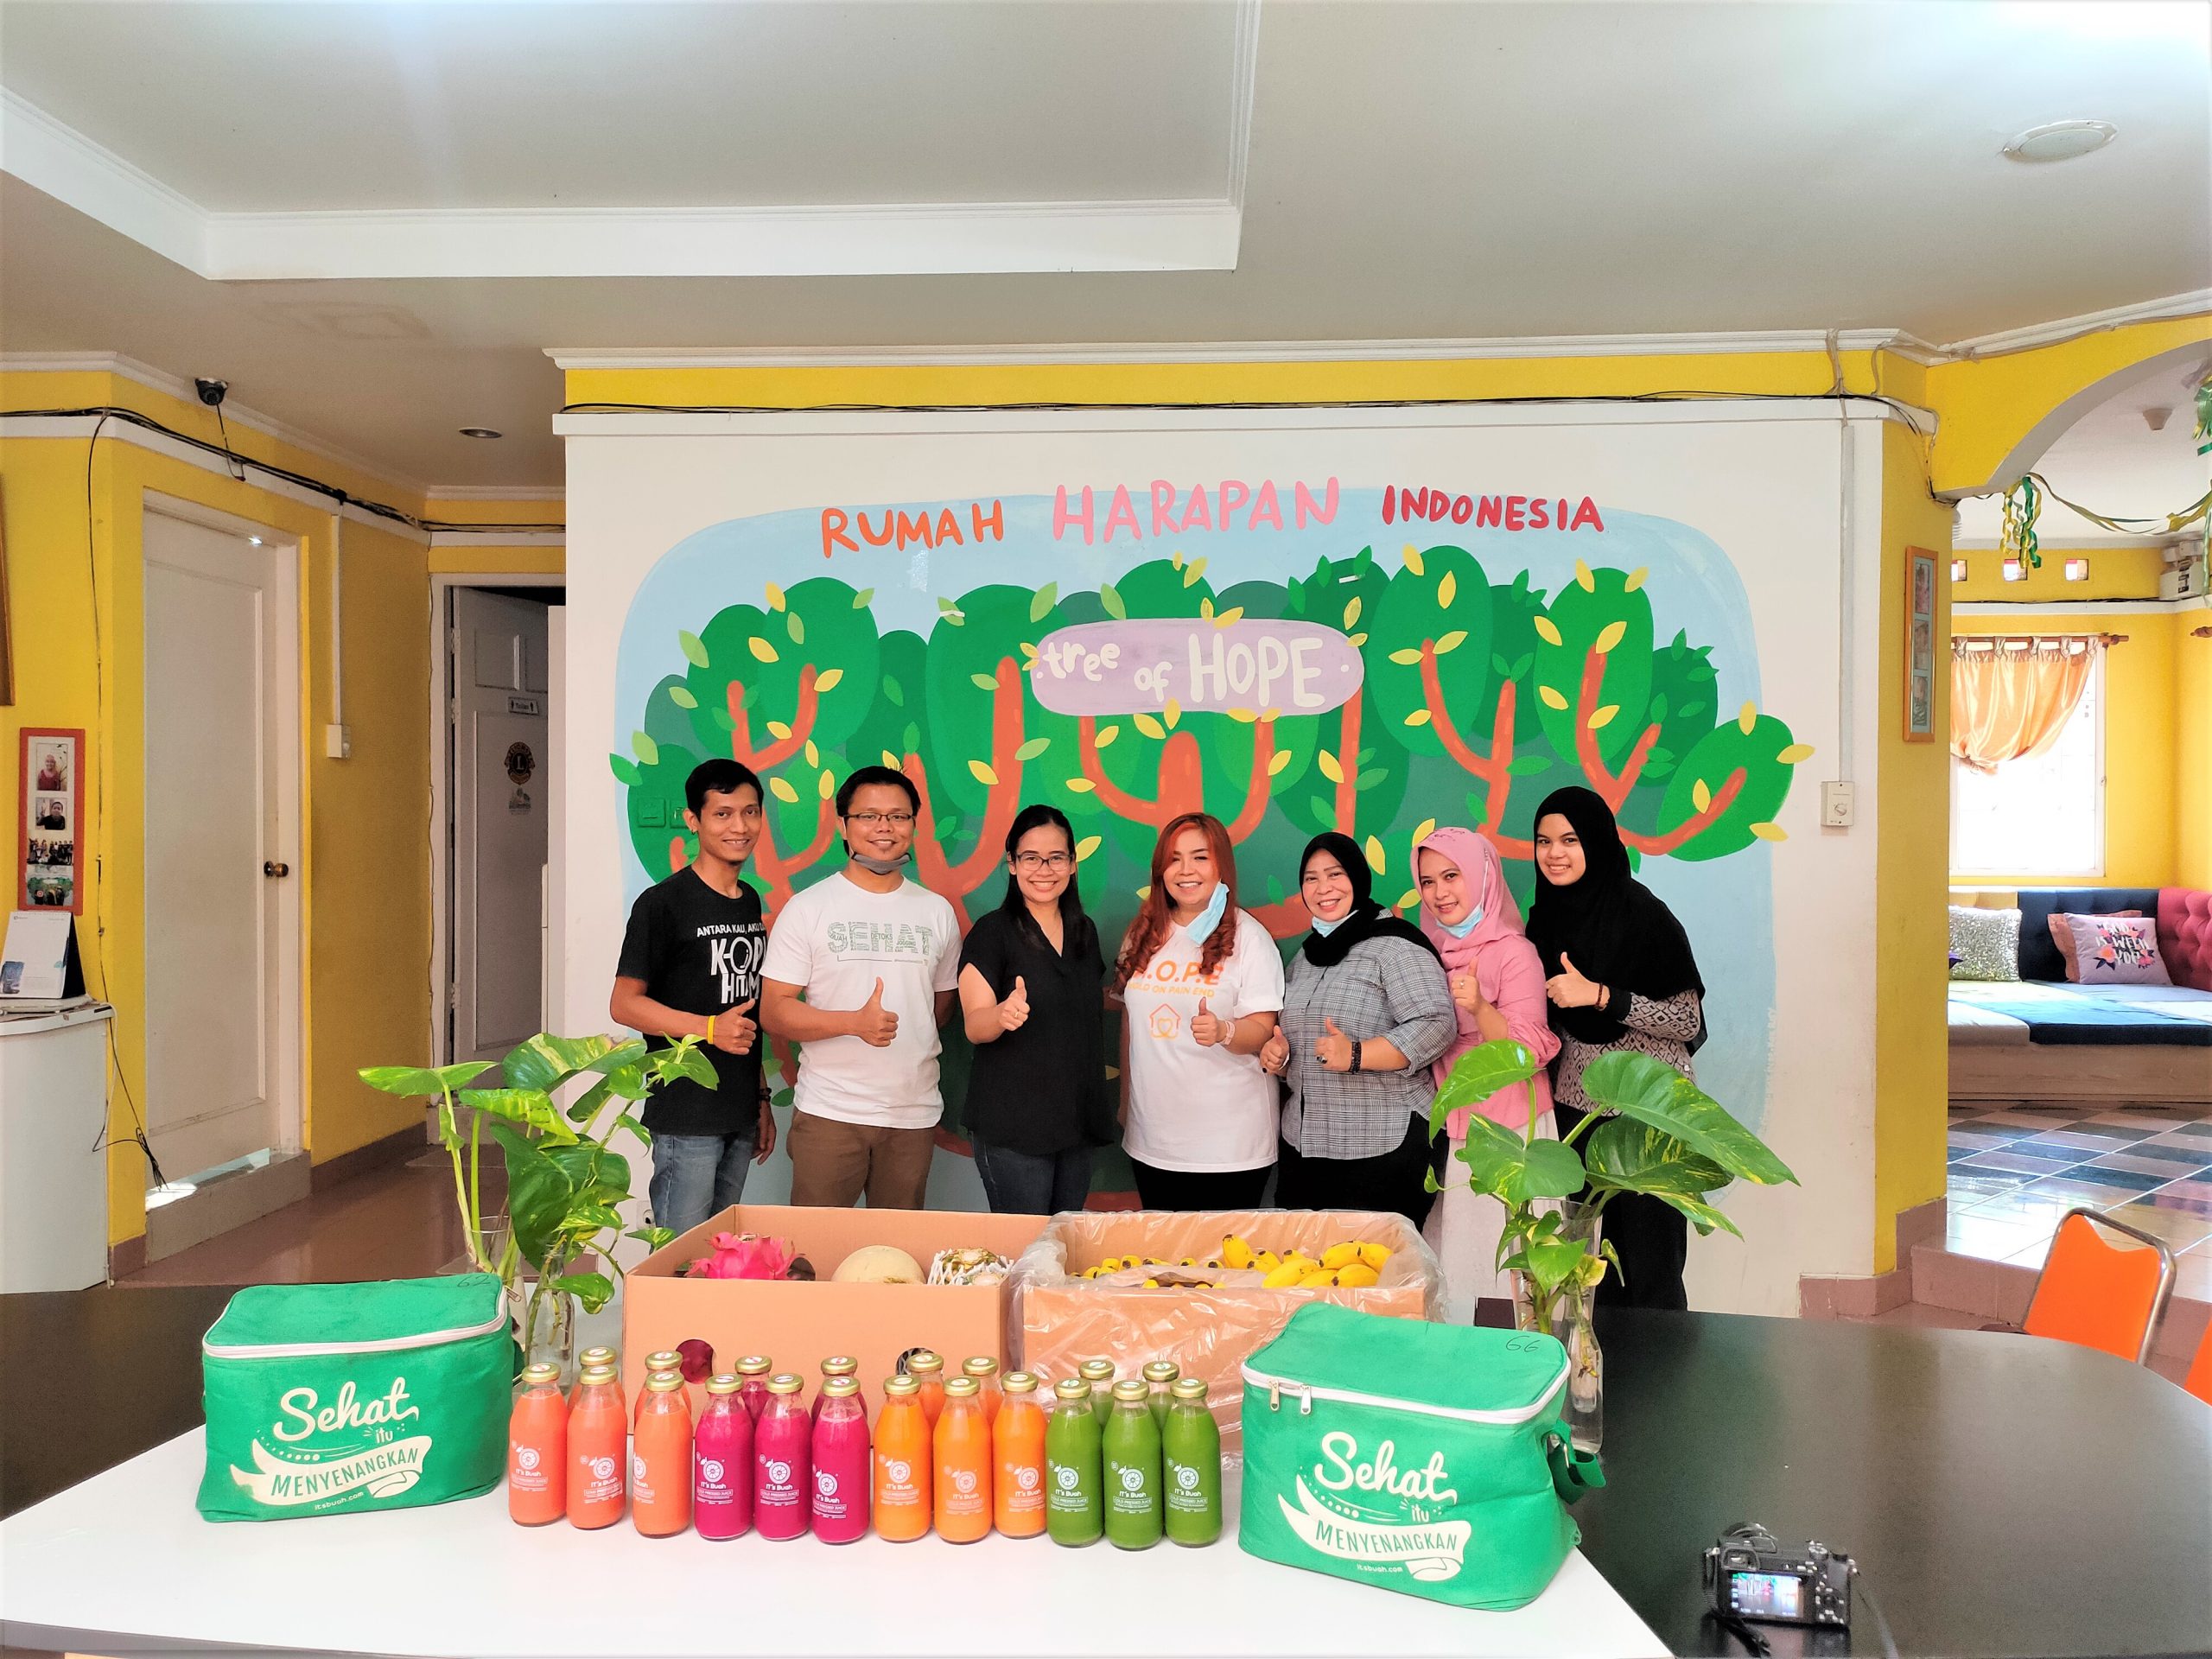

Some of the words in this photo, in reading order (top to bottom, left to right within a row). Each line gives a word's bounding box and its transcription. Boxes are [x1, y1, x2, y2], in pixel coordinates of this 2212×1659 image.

[822, 499, 1003, 558] RUMAH
[1052, 476, 1339, 546] HARAPAN
[1382, 485, 1605, 532] INDONESIA
[1043, 642, 1120, 681] tree
[1134, 662, 1173, 702] of
[1189, 632, 1325, 707] HOPE
[696, 924, 732, 938] ANTARA
[828, 922, 933, 955] SEHAT
[871, 932, 893, 941] DETOKS
[1169, 986, 1190, 995] PAIN
[456, 1274, 491, 1289] 62
[273, 1376, 419, 1442] Sehat
[375, 1427, 394, 1444] itu
[271, 1448, 419, 1497] MENYENANGKAN
[1314, 1431, 1458, 1505] Sehat
[315, 1491, 365, 1510] itsbuah.com
[1411, 1503, 1430, 1522] itu
[1316, 1520, 1458, 1554] MENYENANGKAN
[1357, 1563, 1404, 1573] itsbuah.com
